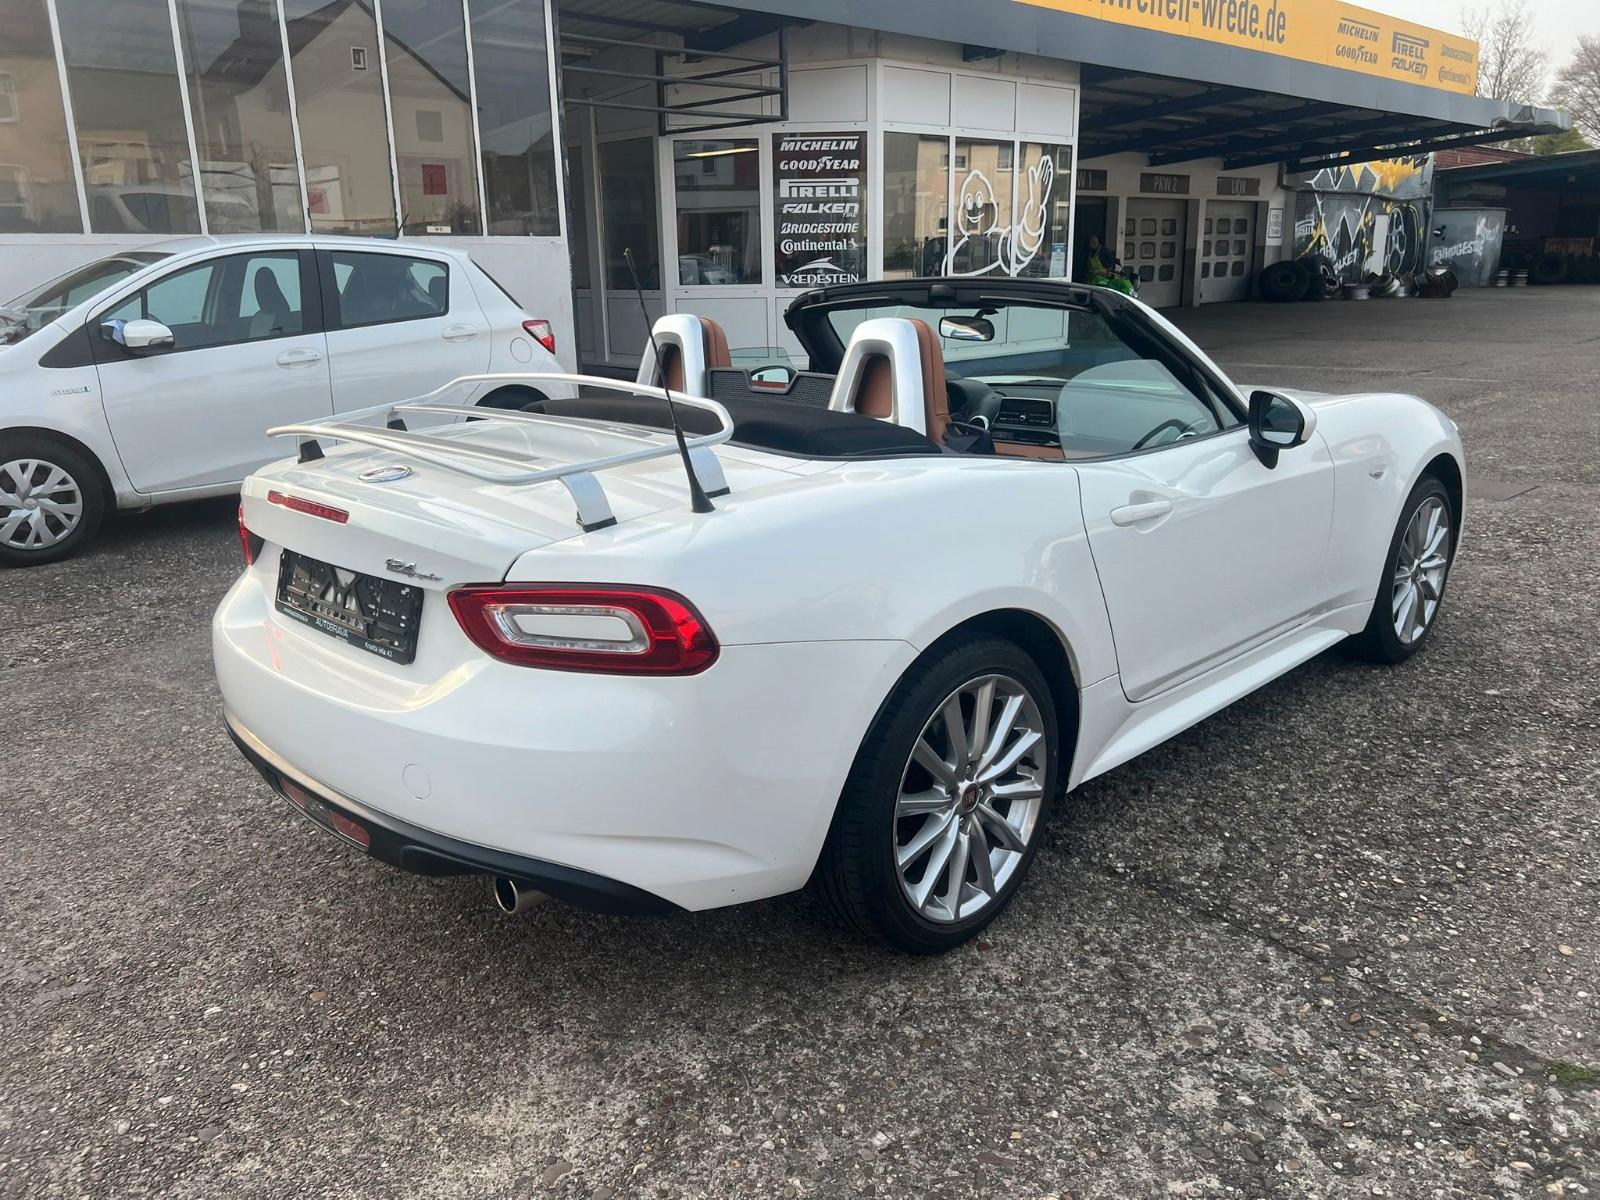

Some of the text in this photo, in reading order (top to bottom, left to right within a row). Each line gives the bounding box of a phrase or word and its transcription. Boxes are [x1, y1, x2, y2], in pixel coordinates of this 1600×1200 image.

[1338, 22, 1380, 43] MICHELIN
[1335, 44, 1379, 65] GOODYEAR
[1391, 57, 1428, 77] FALKEN
[780, 140, 858, 152] MICHELIN
[779, 155, 860, 173] GOODYEAR
[779, 178, 860, 198] PIRELLI
[1153, 175, 1178, 192] PKW 2
[1231, 178, 1247, 194] LKW
[781, 203, 860, 216] FALKEN
[780, 222, 860, 234] BRIDGESTONE
[780, 238, 848, 255] Continental
[781, 273, 859, 284] VREDESTEIN
